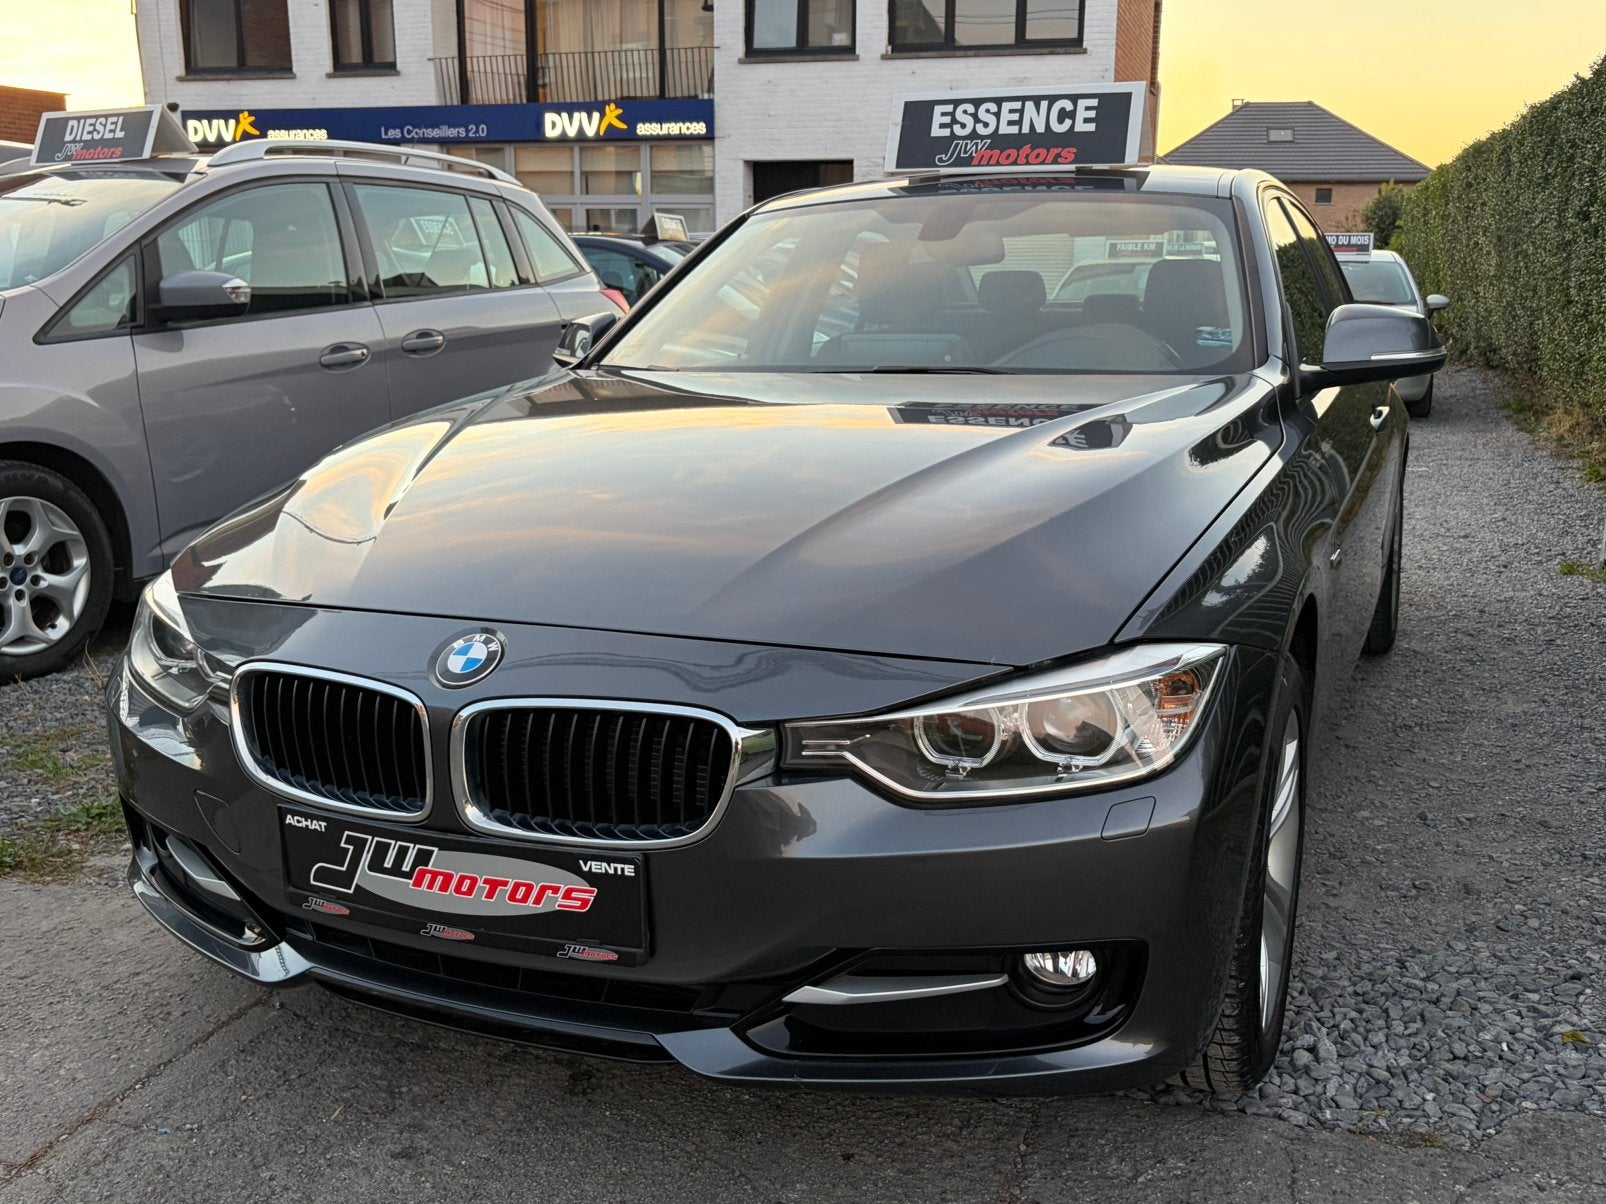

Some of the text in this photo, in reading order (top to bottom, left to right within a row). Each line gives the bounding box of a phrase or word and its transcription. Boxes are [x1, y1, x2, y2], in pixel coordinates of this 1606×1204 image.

[543, 111, 707, 138] DVV assurances
[930, 98, 1099, 137] ESSENCE
[63, 116, 125, 142] DIESEL
[186, 118, 328, 143] DVV assurances
[380, 124, 487, 139] Les Conseillers 2.0
[72, 145, 122, 160] motors
[971, 144, 1077, 166] motors
[1338, 235, 1349, 245] DU
[1350, 235, 1369, 245] MOIS
[285, 815, 327, 832] ACHAT
[578, 859, 636, 877] VENTE
